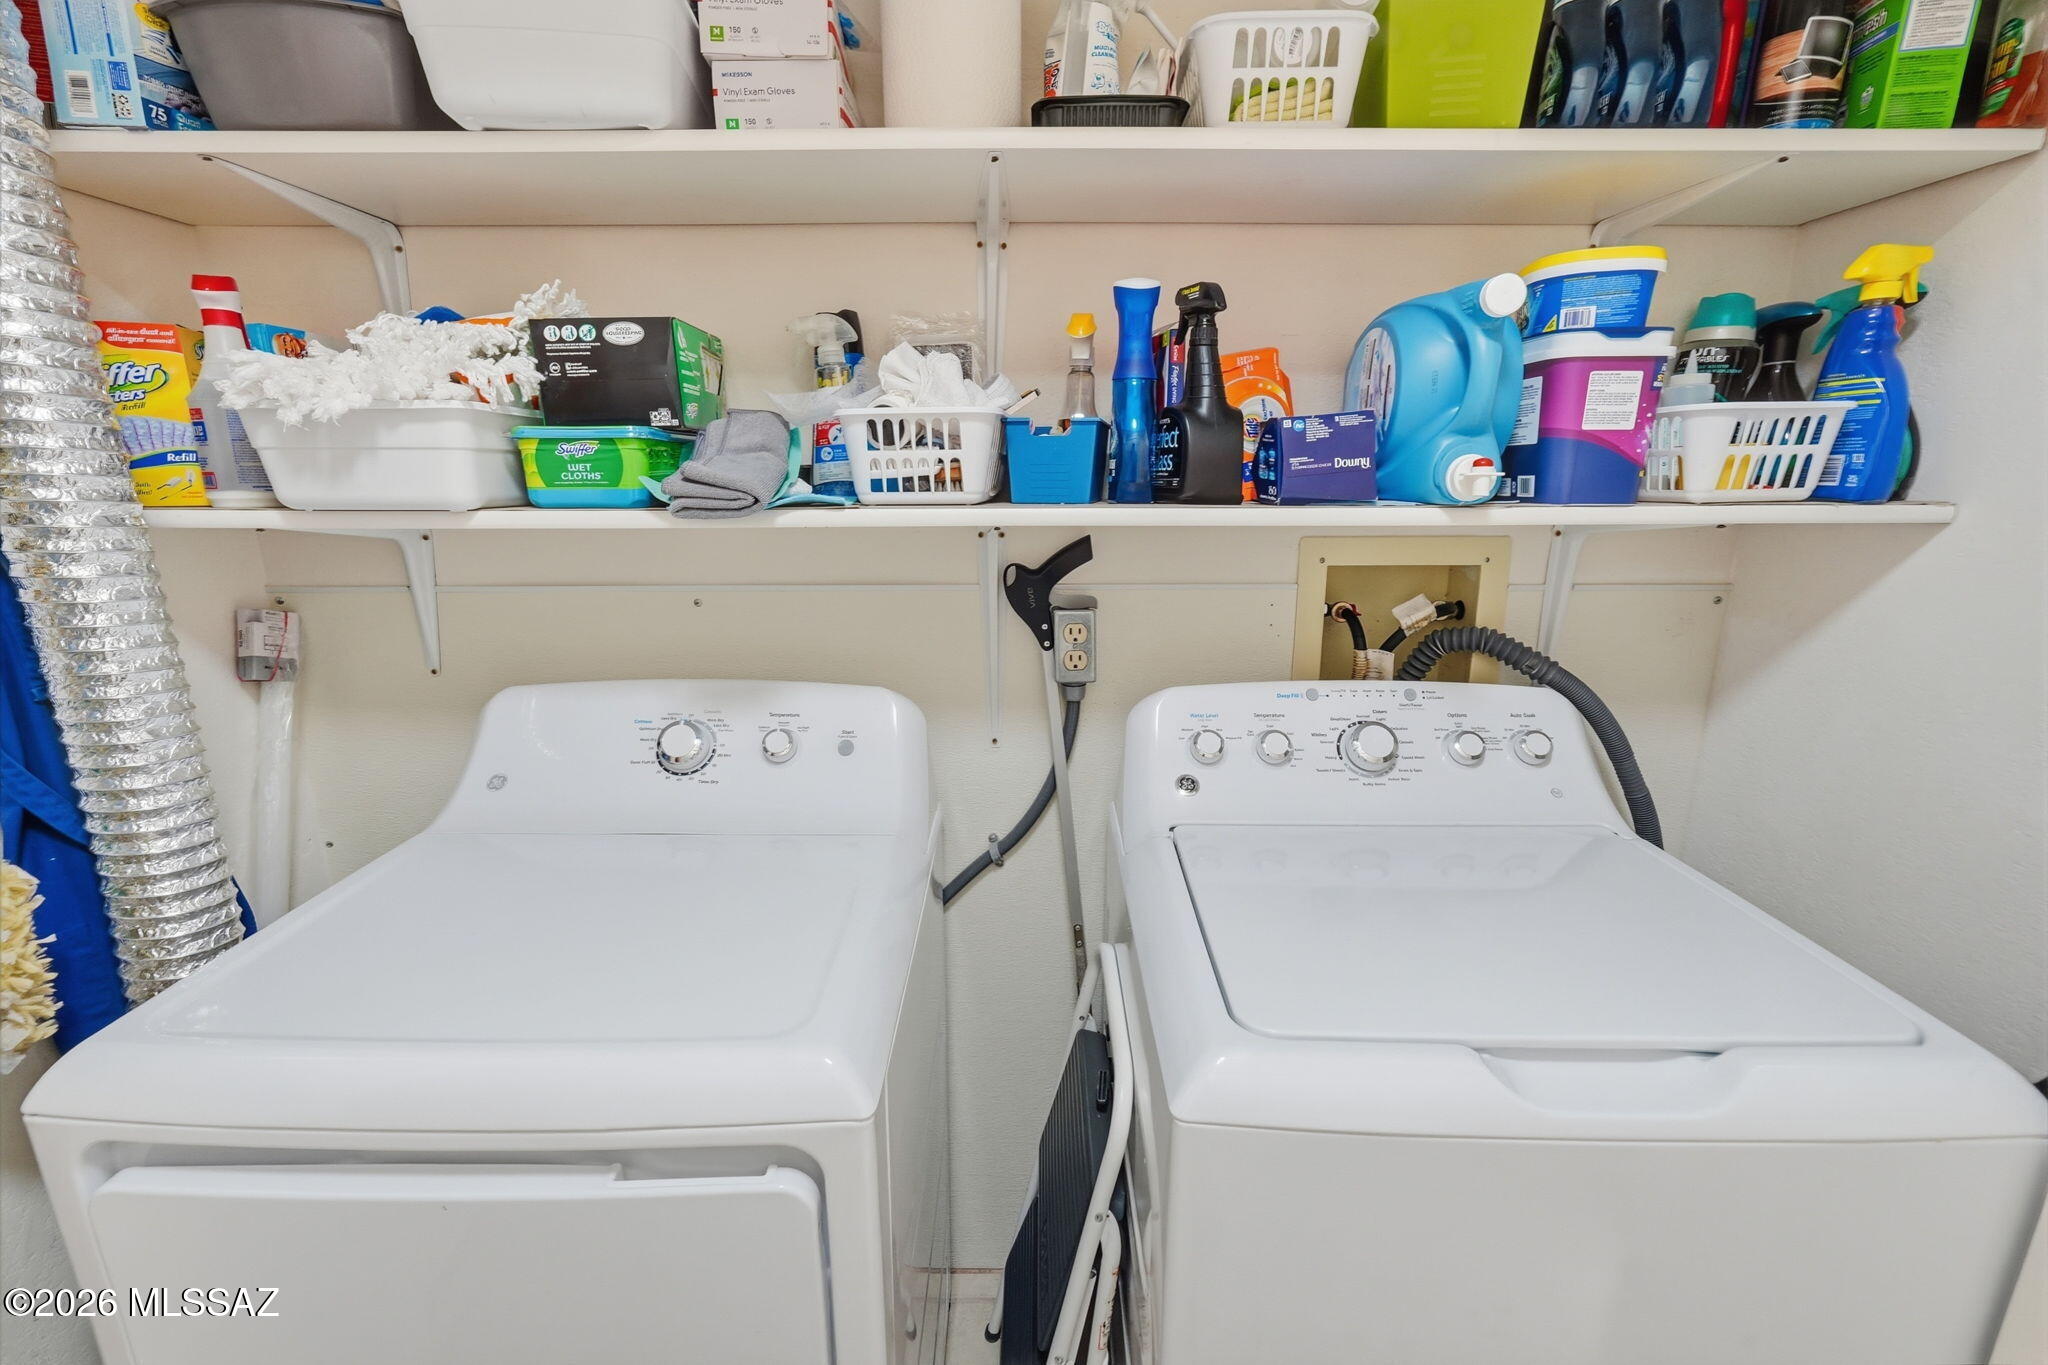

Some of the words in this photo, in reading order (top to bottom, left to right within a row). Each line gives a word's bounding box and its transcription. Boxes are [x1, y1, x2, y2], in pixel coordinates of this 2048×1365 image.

[729, 26, 741, 34] 150
[722, 87, 743, 98] Vinyl
[744, 87, 766, 96] Exam
[766, 86, 796, 96] Gloves
[148, 103, 168, 122] 75
[109, 361, 162, 386] ffer
[110, 389, 146, 402] ters
[555, 440, 600, 457] Swiffer
[166, 453, 197, 462] Refill
[1334, 457, 1371, 469] Downy
[567, 463, 592, 472] WET
[560, 472, 602, 481] CLOTHS
[1276, 692, 1290, 700] Deep
